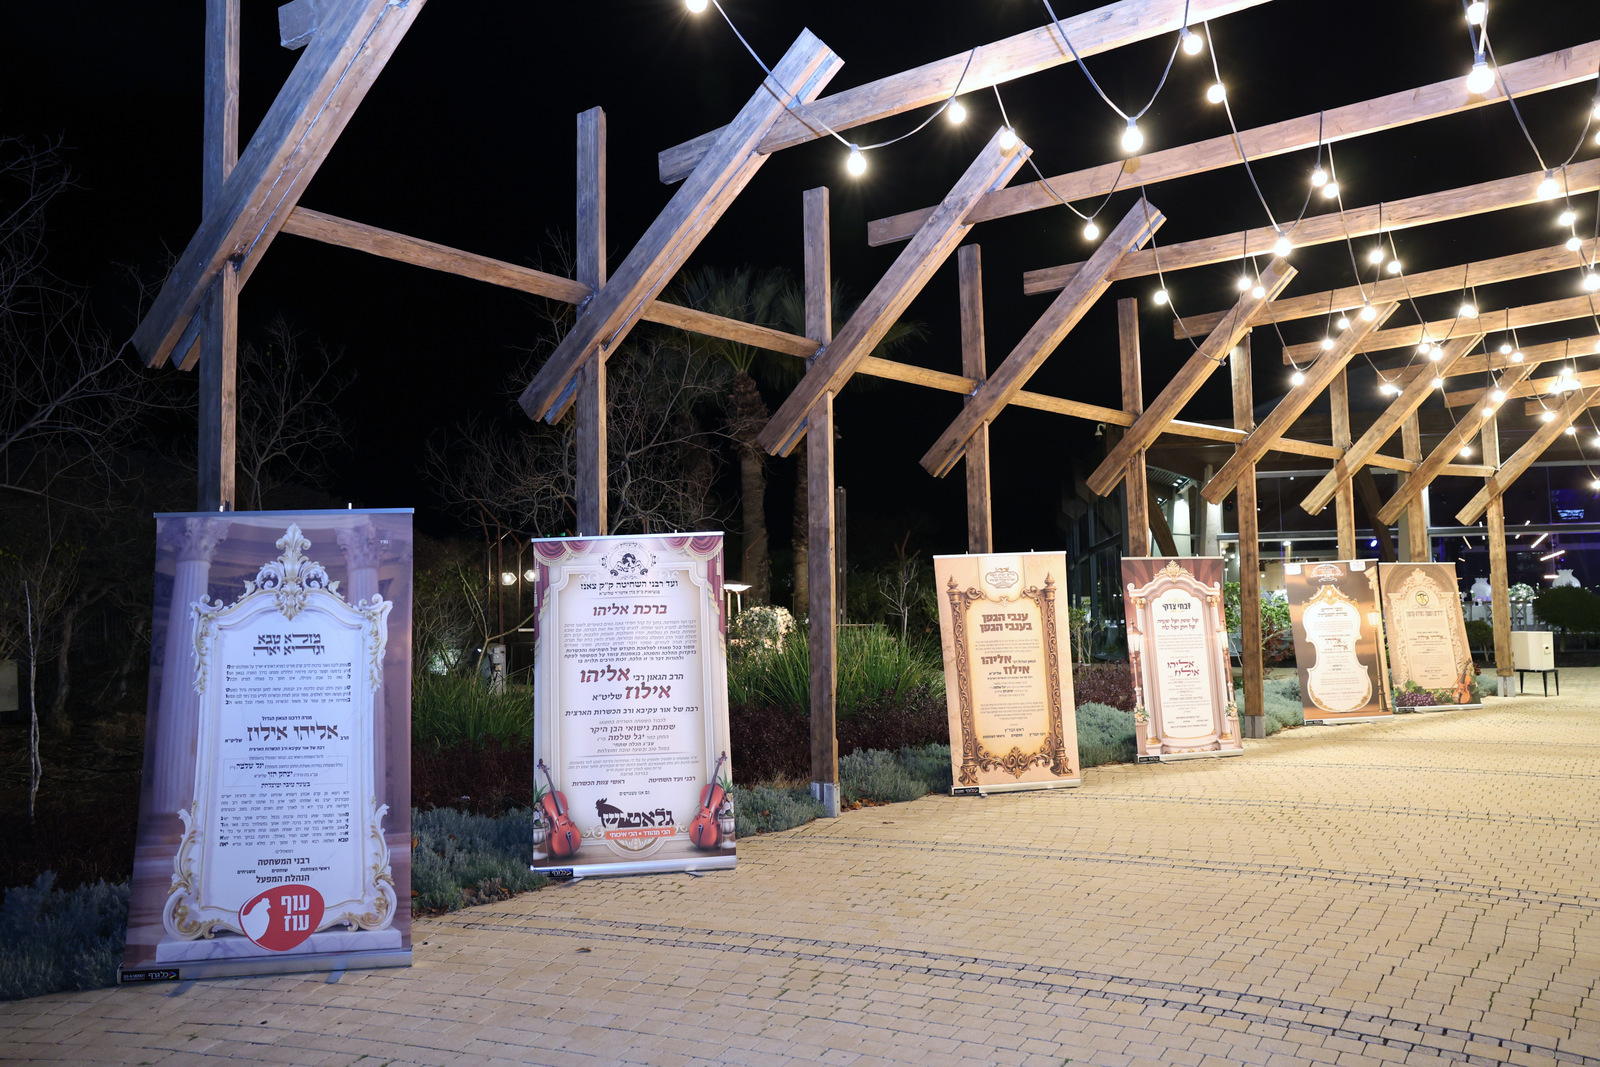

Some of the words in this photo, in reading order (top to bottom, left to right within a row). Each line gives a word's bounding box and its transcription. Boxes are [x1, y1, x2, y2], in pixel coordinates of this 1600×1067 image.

[592, 604, 629, 616] אליהו
[632, 604, 667, 615] ברכת
[982, 614, 1005, 623] הגפן
[1007, 613, 1028, 621] ענבי
[980, 623, 1003, 633] הגפן
[1005, 623, 1032, 631] בענבי
[258, 634, 281, 644] טבא
[284, 633, 321, 644] מזלא
[253, 646, 280, 656] יאה
[981, 654, 1011, 664] אליהו
[1167, 659, 1194, 668] אליהו
[580, 664, 630, 683] אליהו
[1003, 665, 1030, 674] אילוז
[625, 682, 671, 699] אילוז
[592, 693, 622, 701] שליט"א
[247, 722, 288, 741] אילוז
[293, 721, 338, 740] אליהו
[281, 895, 310, 914] עוף
[284, 914, 310, 931] עוז
